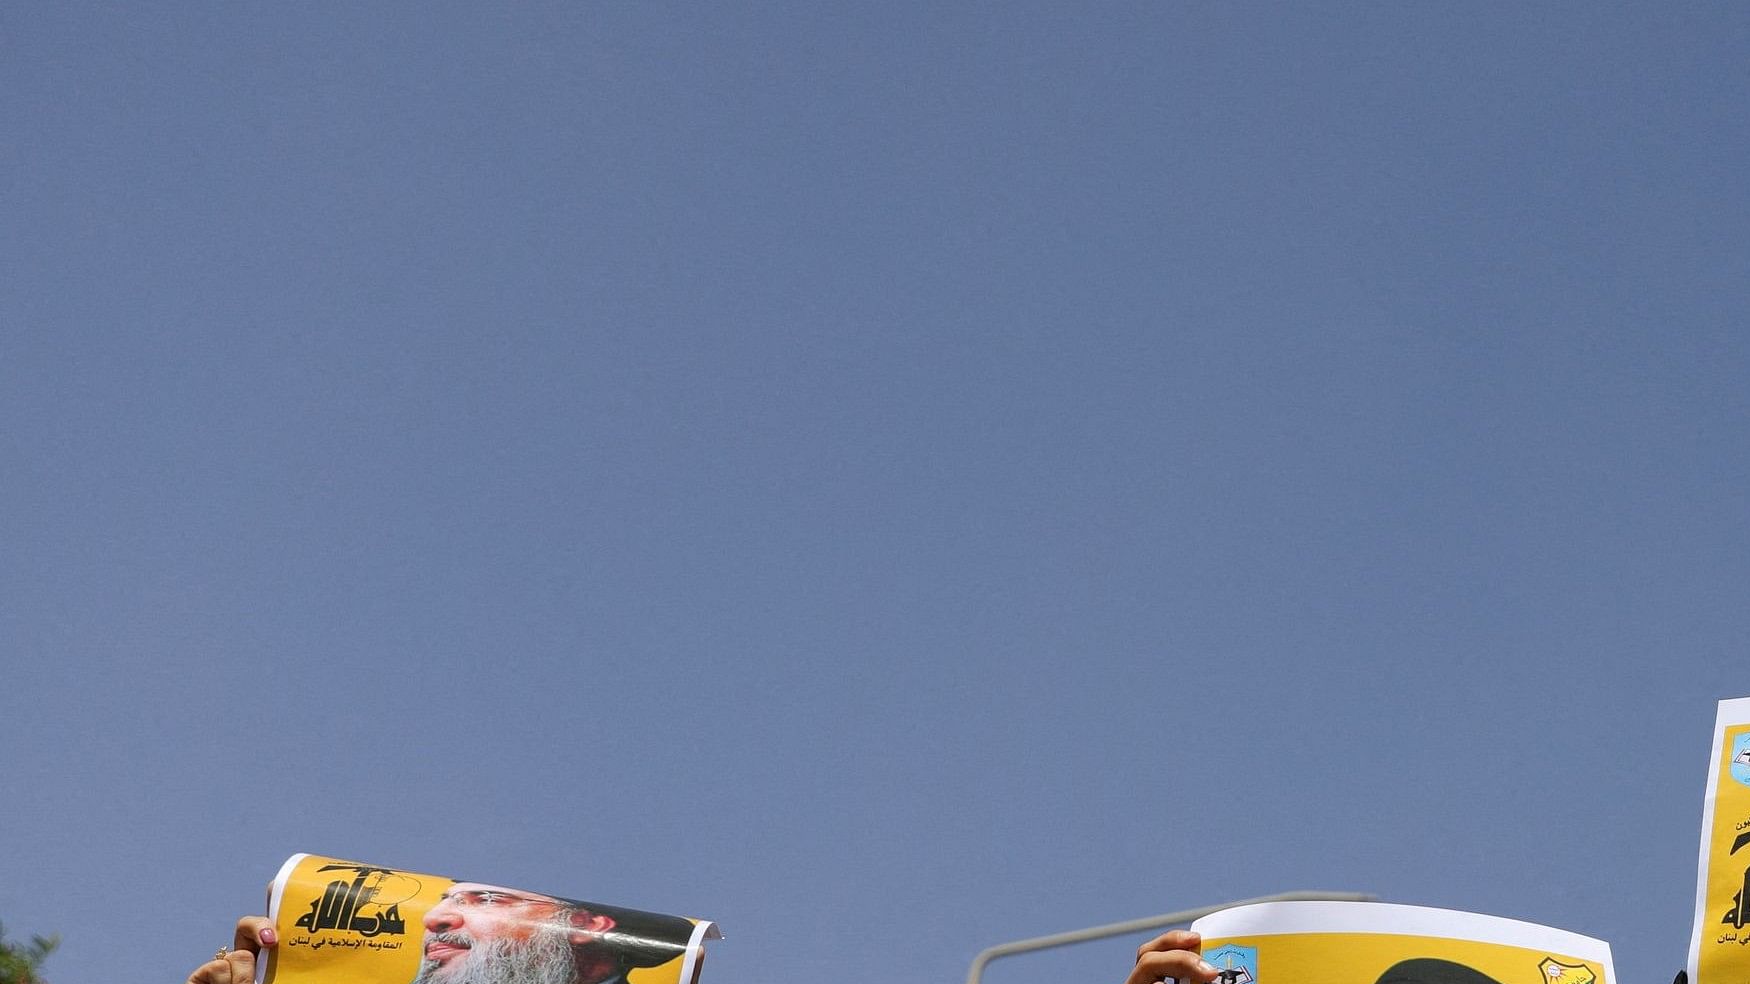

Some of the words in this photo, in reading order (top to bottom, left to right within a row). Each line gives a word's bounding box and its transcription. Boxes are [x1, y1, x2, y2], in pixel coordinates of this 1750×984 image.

[289, 937, 310, 947] لبنان
[312, 937, 325, 950] في
[1717, 933, 1737, 945] لبنان
[328, 940, 365, 949] الإسلامية
[368, 942, 402, 951] المقاومة
